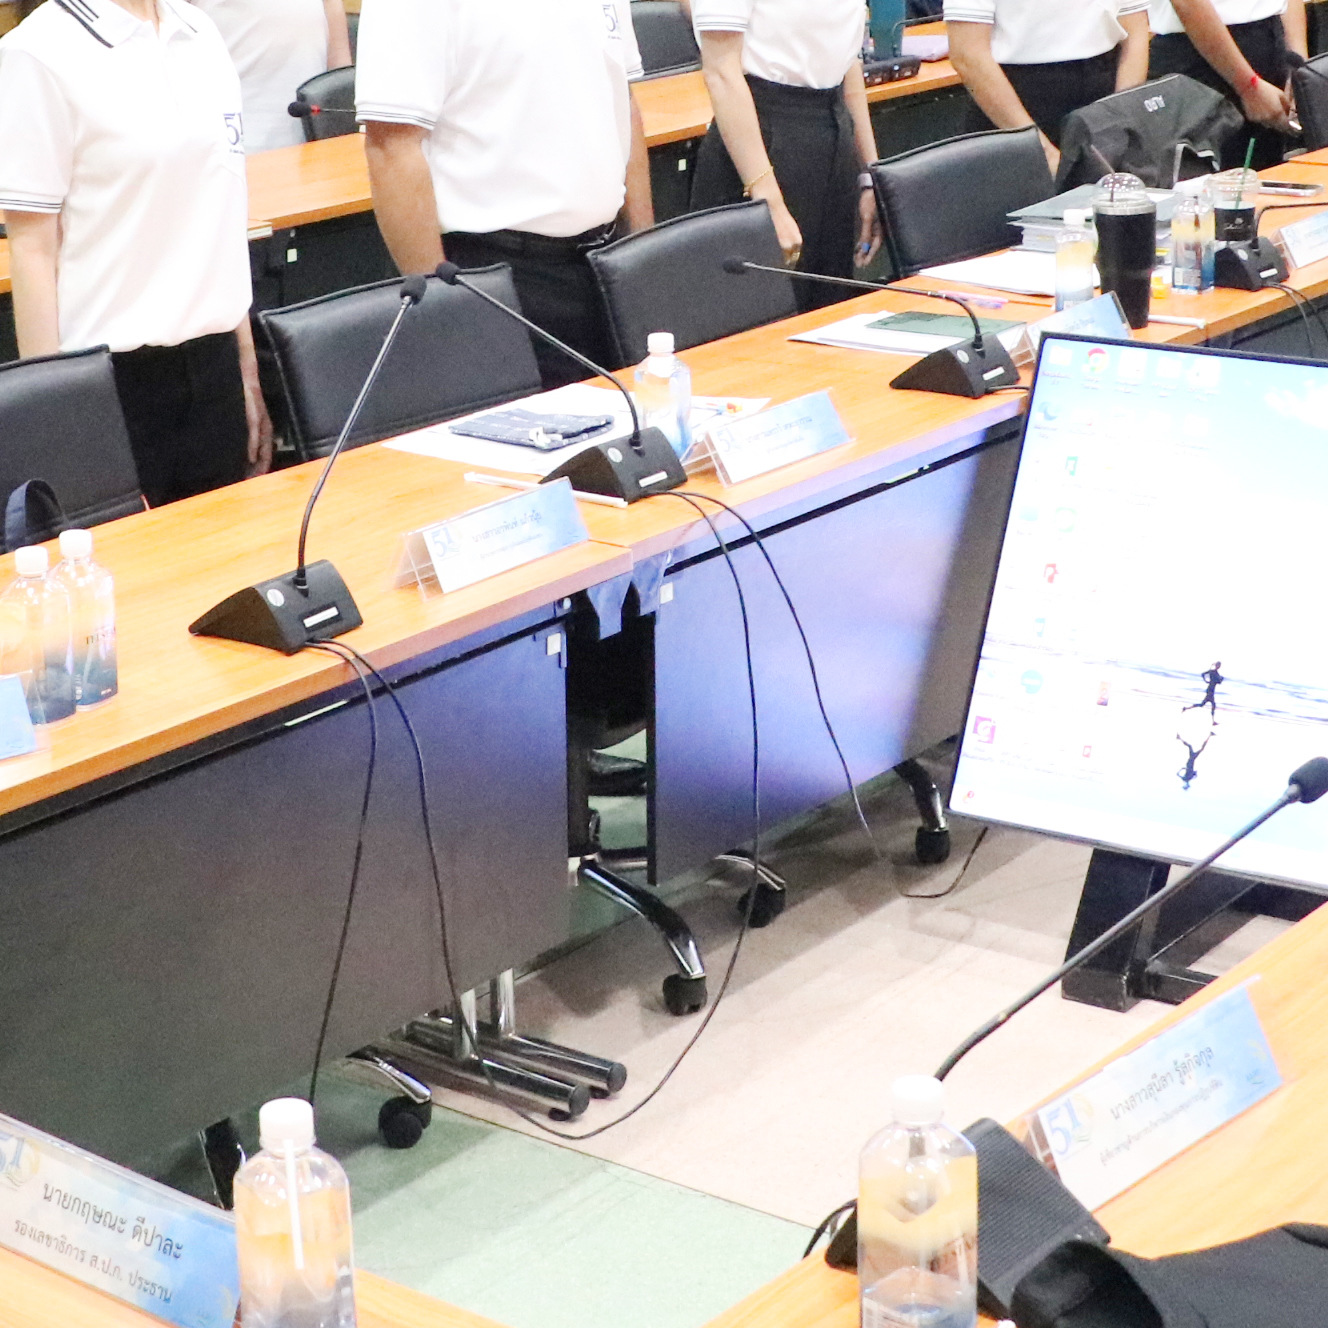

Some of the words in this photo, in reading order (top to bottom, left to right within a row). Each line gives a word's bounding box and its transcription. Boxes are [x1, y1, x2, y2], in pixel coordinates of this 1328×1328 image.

[222, 112, 244, 146] 51
[429, 526, 456, 559] 51
[1046, 1099, 1080, 1156] 51
[43, 1183, 127, 1234] นายกฤษณะ
[14, 1219, 86, 1263] รองเลขาธิการ
[129, 1271, 173, 1304] ประธาน
